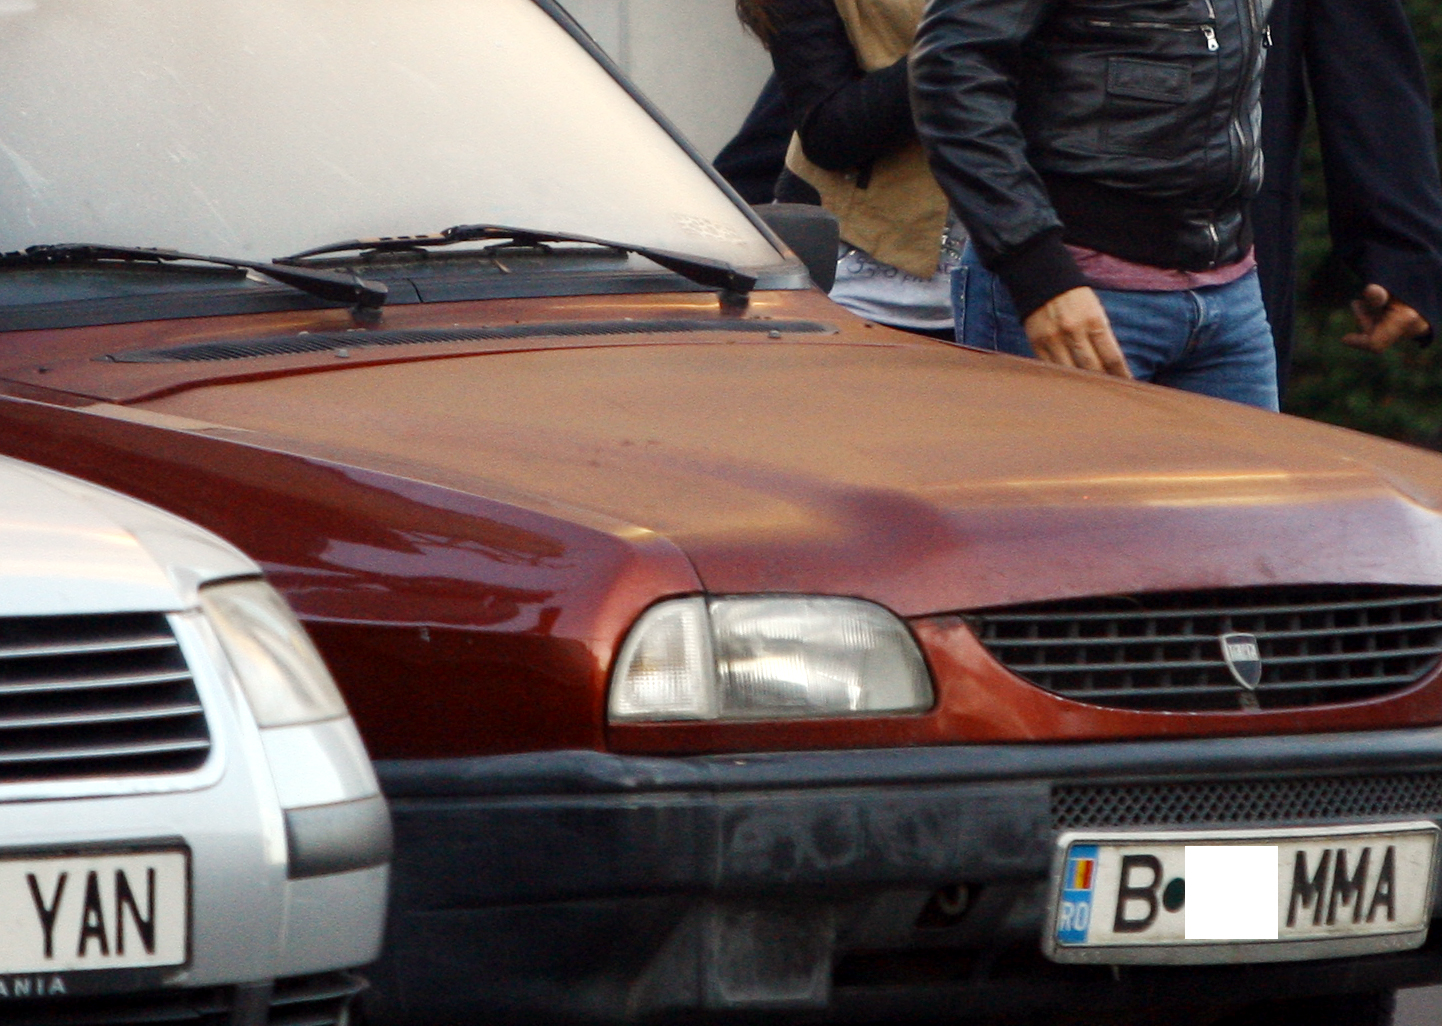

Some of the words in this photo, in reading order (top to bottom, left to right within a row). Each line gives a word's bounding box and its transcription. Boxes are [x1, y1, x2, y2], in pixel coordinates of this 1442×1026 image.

[26, 867, 156, 959] YAN
[1060, 901, 1089, 932] RO
[1113, 854, 1163, 933] B
[1286, 845, 1396, 928] MMA
